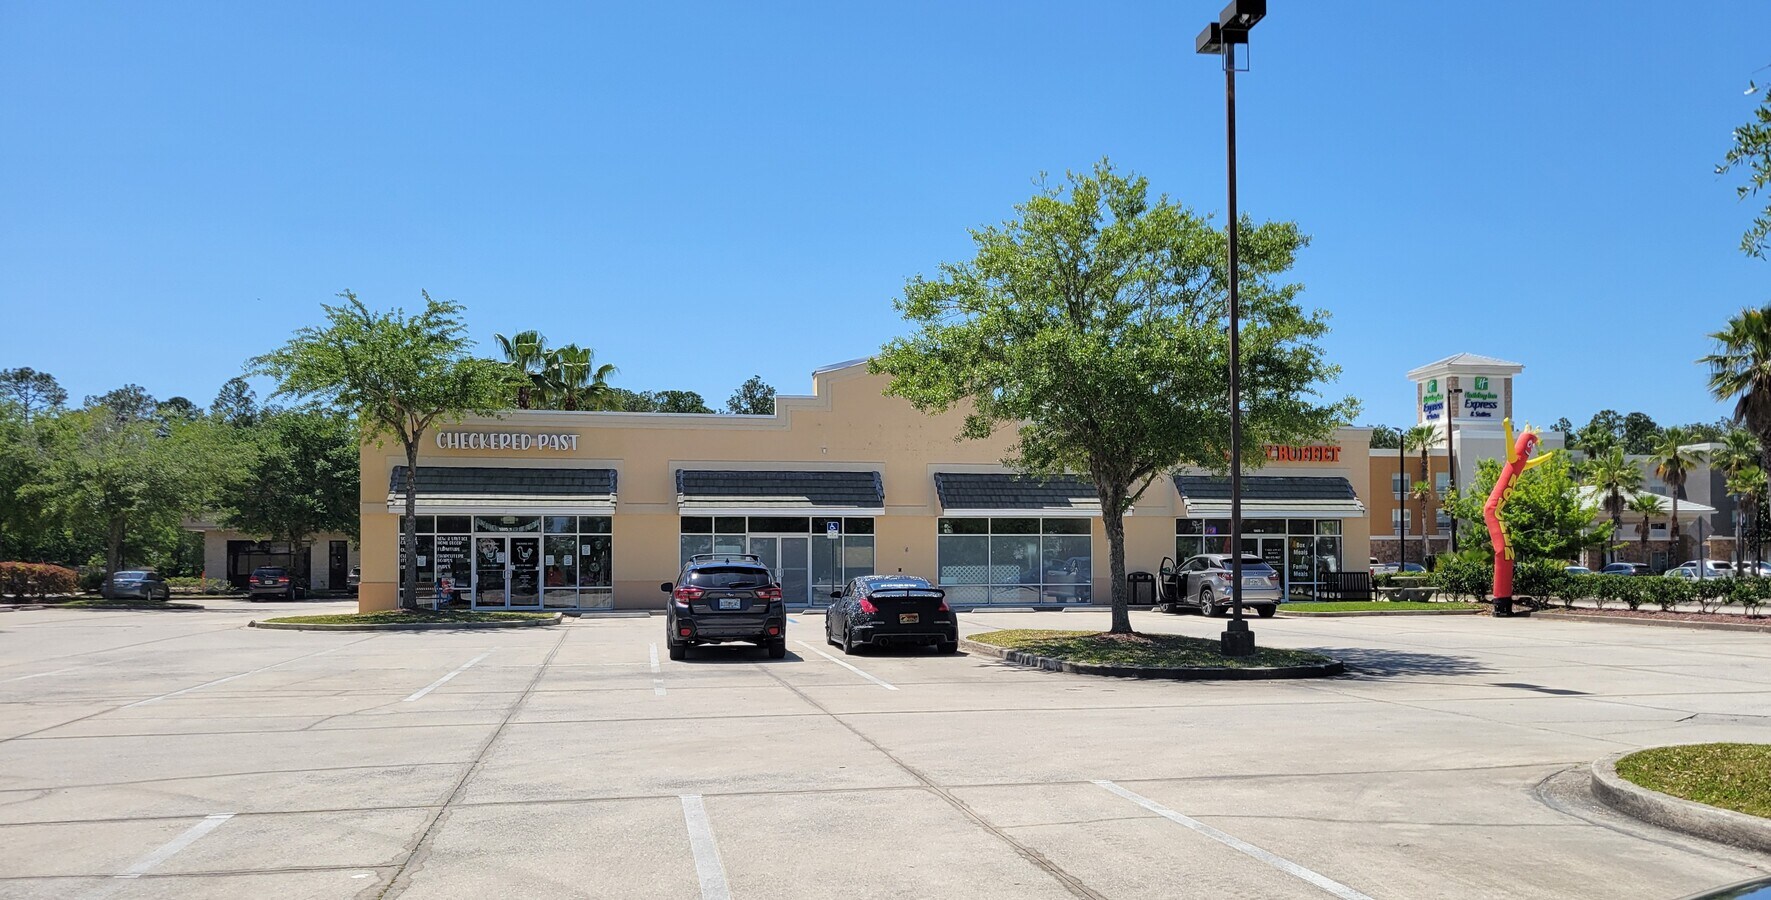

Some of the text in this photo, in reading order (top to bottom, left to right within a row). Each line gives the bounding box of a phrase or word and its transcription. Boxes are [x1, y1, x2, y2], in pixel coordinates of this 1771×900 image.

[1465, 399, 1498, 411] Express
[436, 432, 580, 451] CHECKERED PAST
[1278, 445, 1341, 462] BUFFET
[1292, 563, 1310, 571] Family
